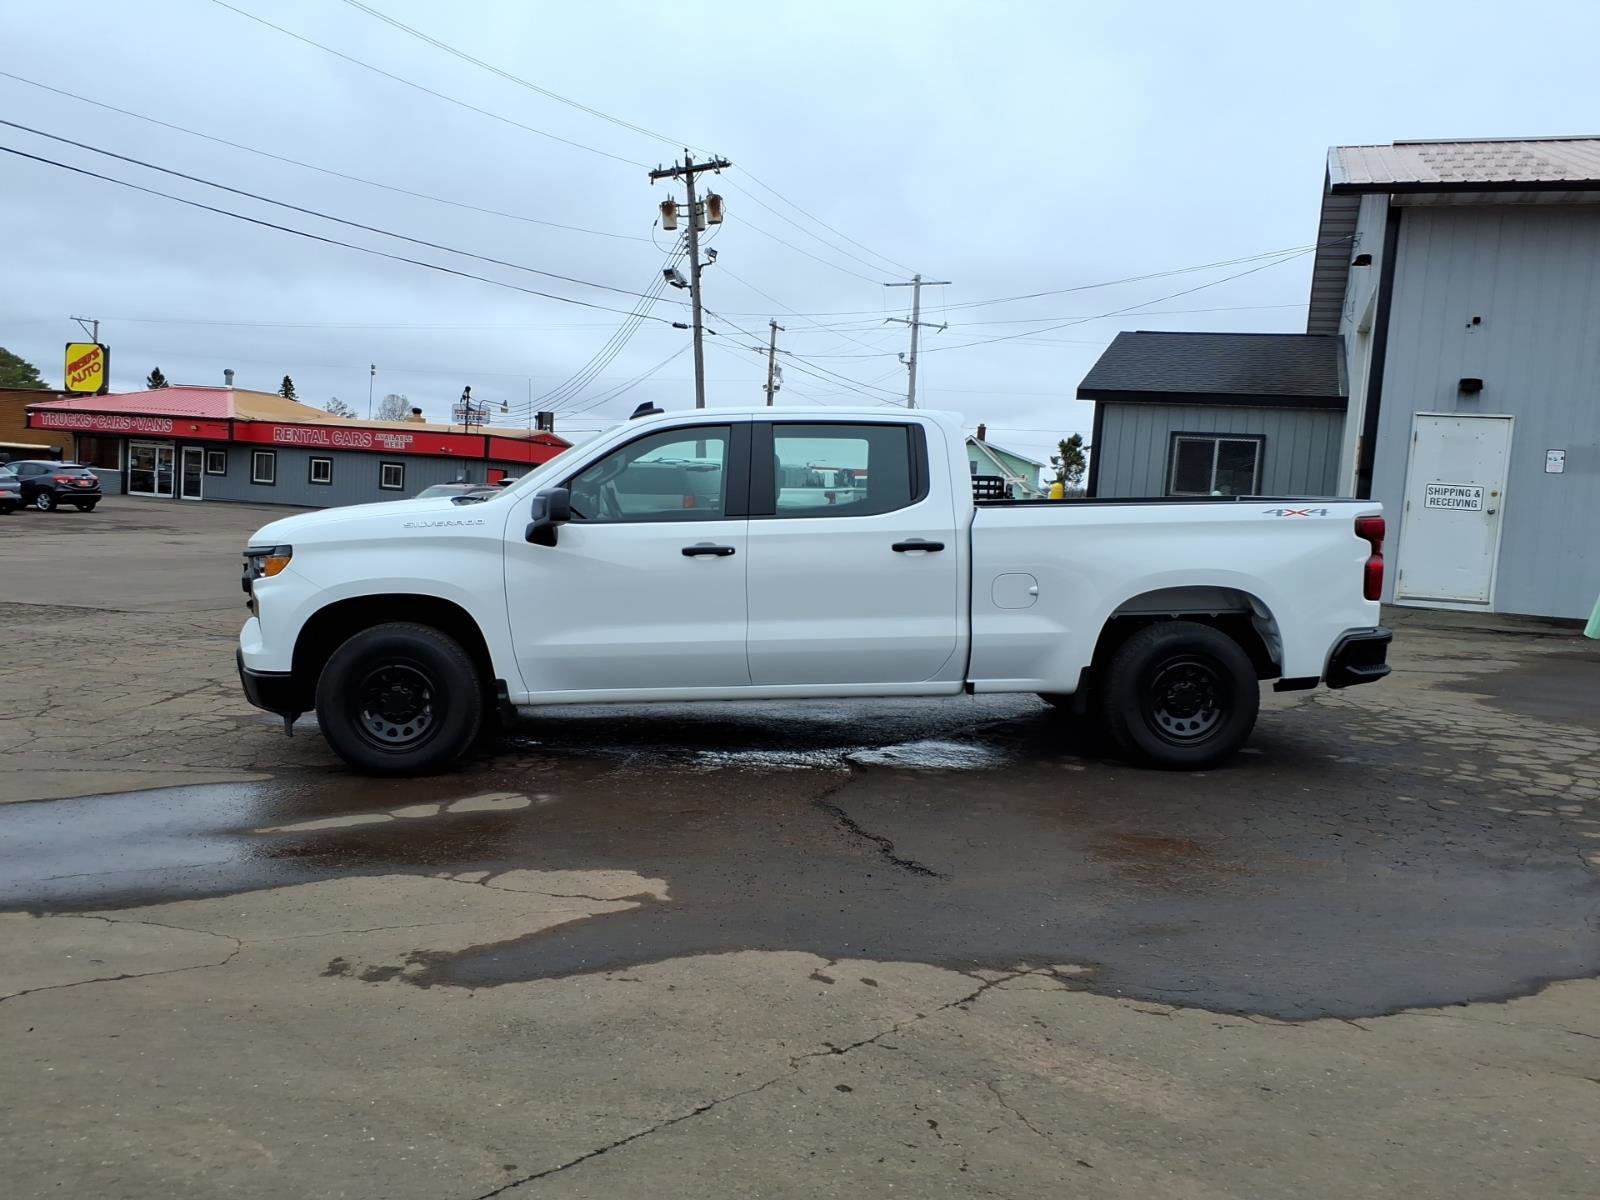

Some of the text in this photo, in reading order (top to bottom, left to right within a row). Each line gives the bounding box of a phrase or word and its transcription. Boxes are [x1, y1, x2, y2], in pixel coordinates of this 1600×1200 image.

[71, 362, 101, 387] AUTO
[273, 426, 373, 447] RENTAL CARS
[374, 433, 414, 442] AVAILABLE
[383, 441, 406, 449] HERE
[1428, 487, 1481, 498] SHIPPING &
[1429, 497, 1478, 508] RECEIVING
[402, 519, 487, 528] SILVERADO
